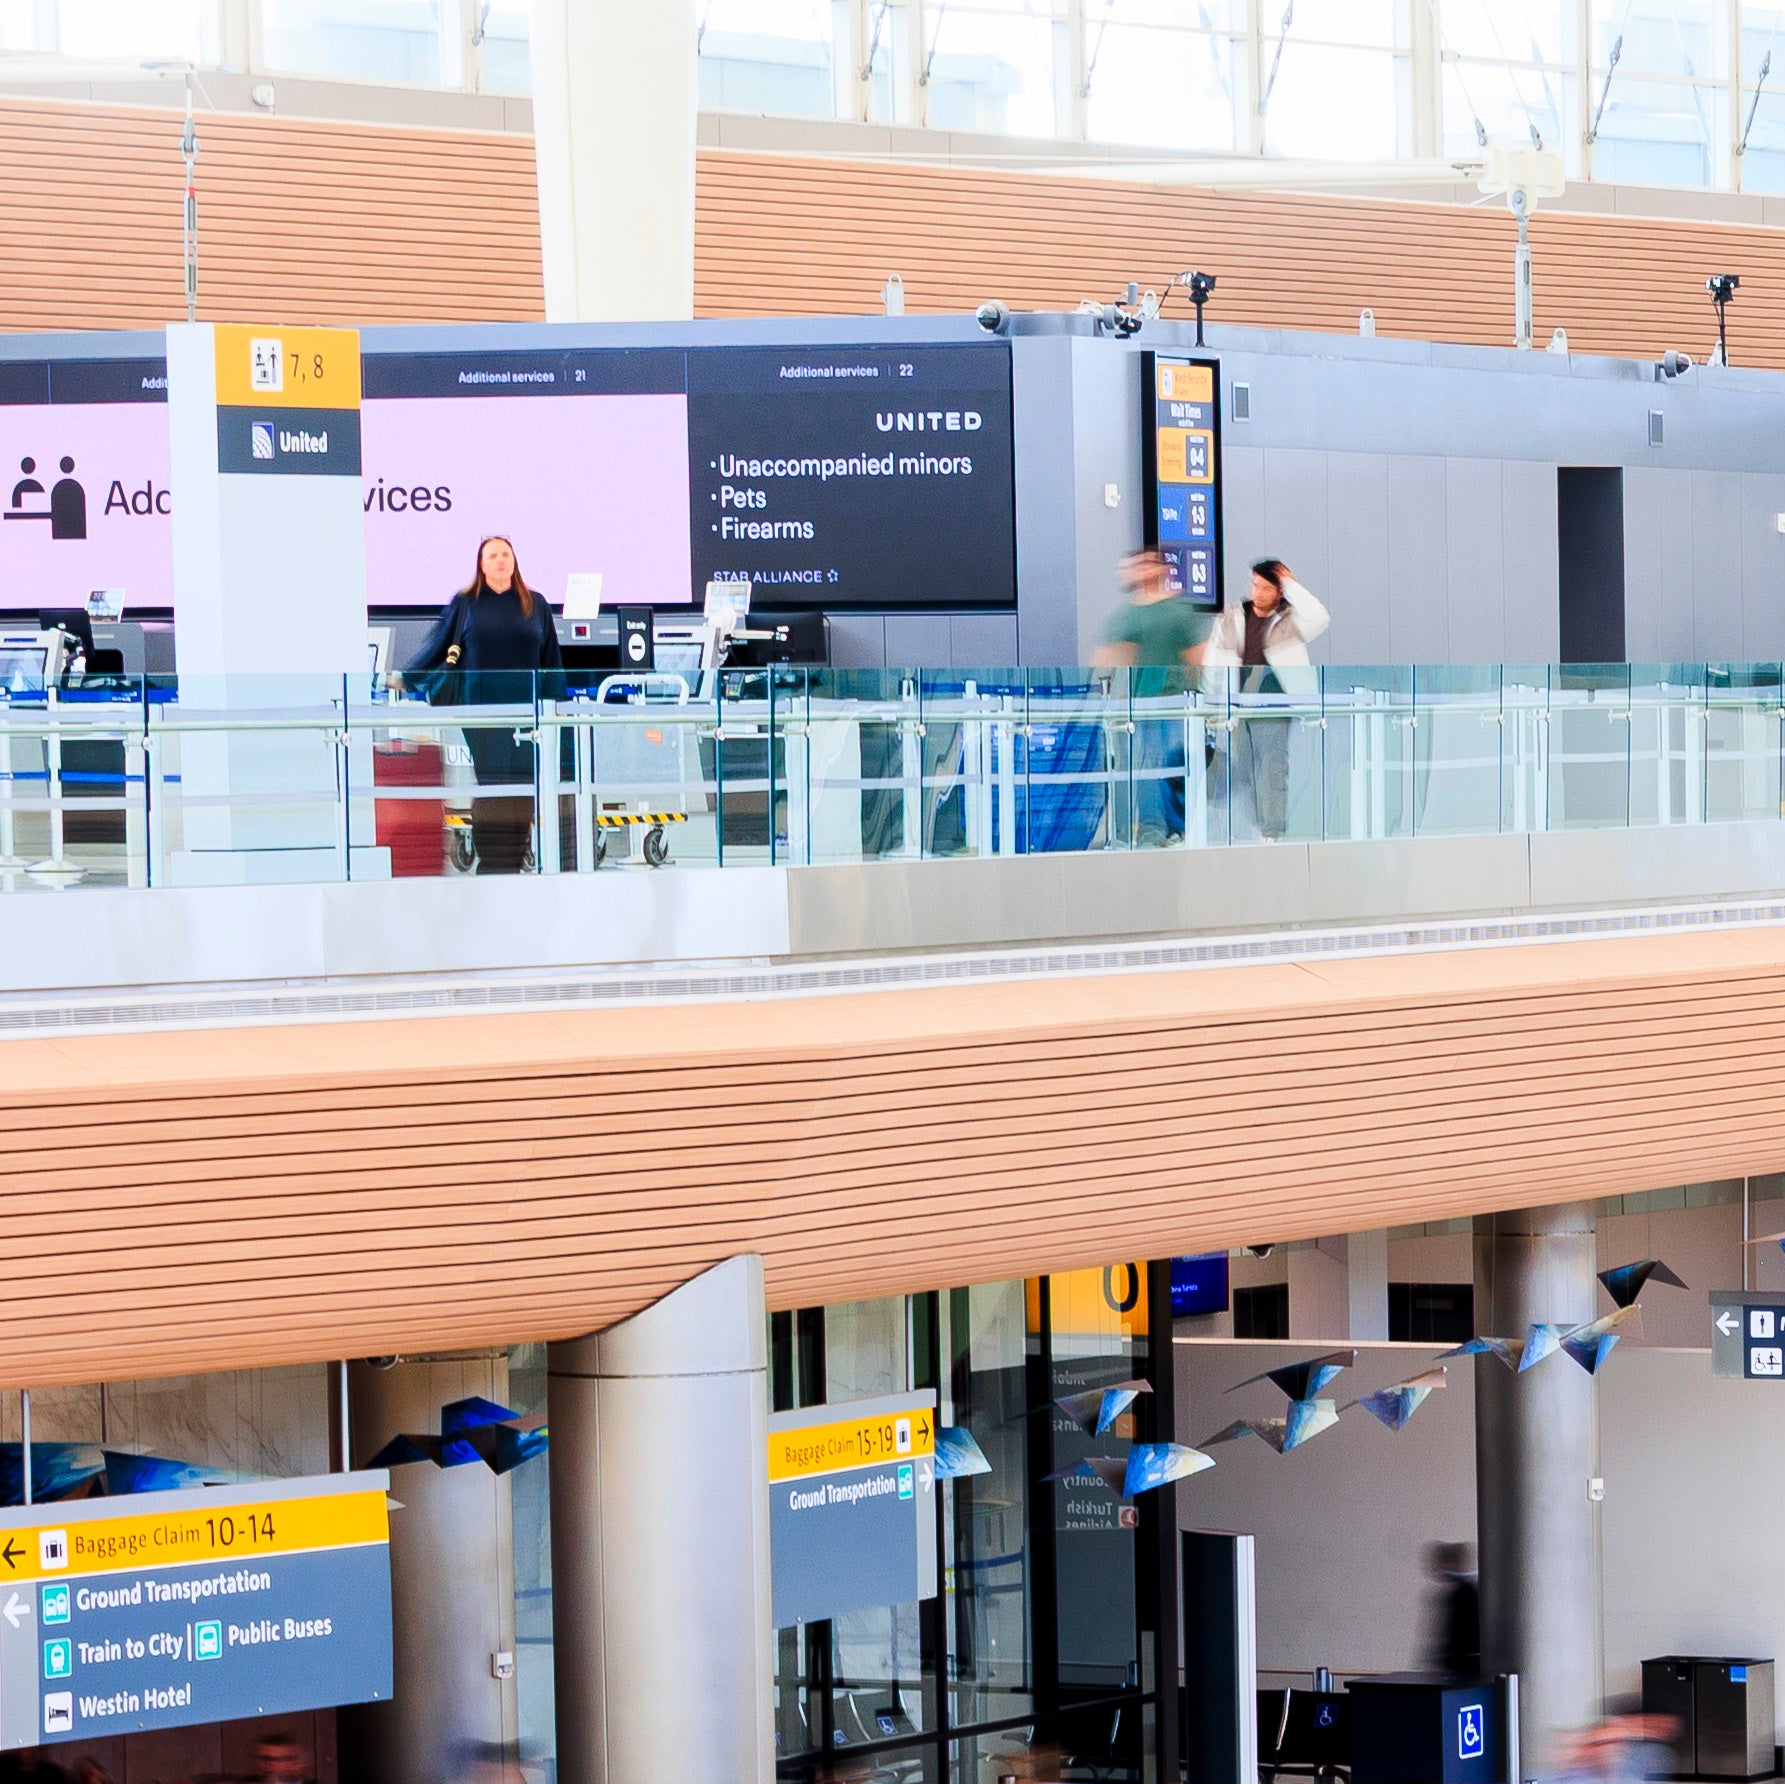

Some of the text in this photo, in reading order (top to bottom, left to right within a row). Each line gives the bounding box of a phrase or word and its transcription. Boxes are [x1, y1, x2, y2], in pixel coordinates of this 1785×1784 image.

[313, 355, 323, 378] 8
[459, 370, 586, 384] Additional services 21
[779, 364, 913, 378] Additional services 22
[876, 412, 981, 431] UNITED
[280, 432, 328, 453] United
[719, 453, 972, 479] Unaccompanied minors
[721, 486, 767, 509] Pets
[721, 516, 814, 539] Firearms
[754, 569, 822, 582] ALLIANCE
[786, 1425, 893, 1465] Baggage Claim 15-19
[790, 1476, 895, 1510] Ground Transportation
[75, 1513, 275, 1559] Baggage Claim 10-14
[77, 1569, 271, 1610] Ground Transportation
[229, 1616, 332, 1647] Public Buses
[79, 1634, 184, 1664] Train to City
[79, 1683, 191, 1718] Westin Hotel
